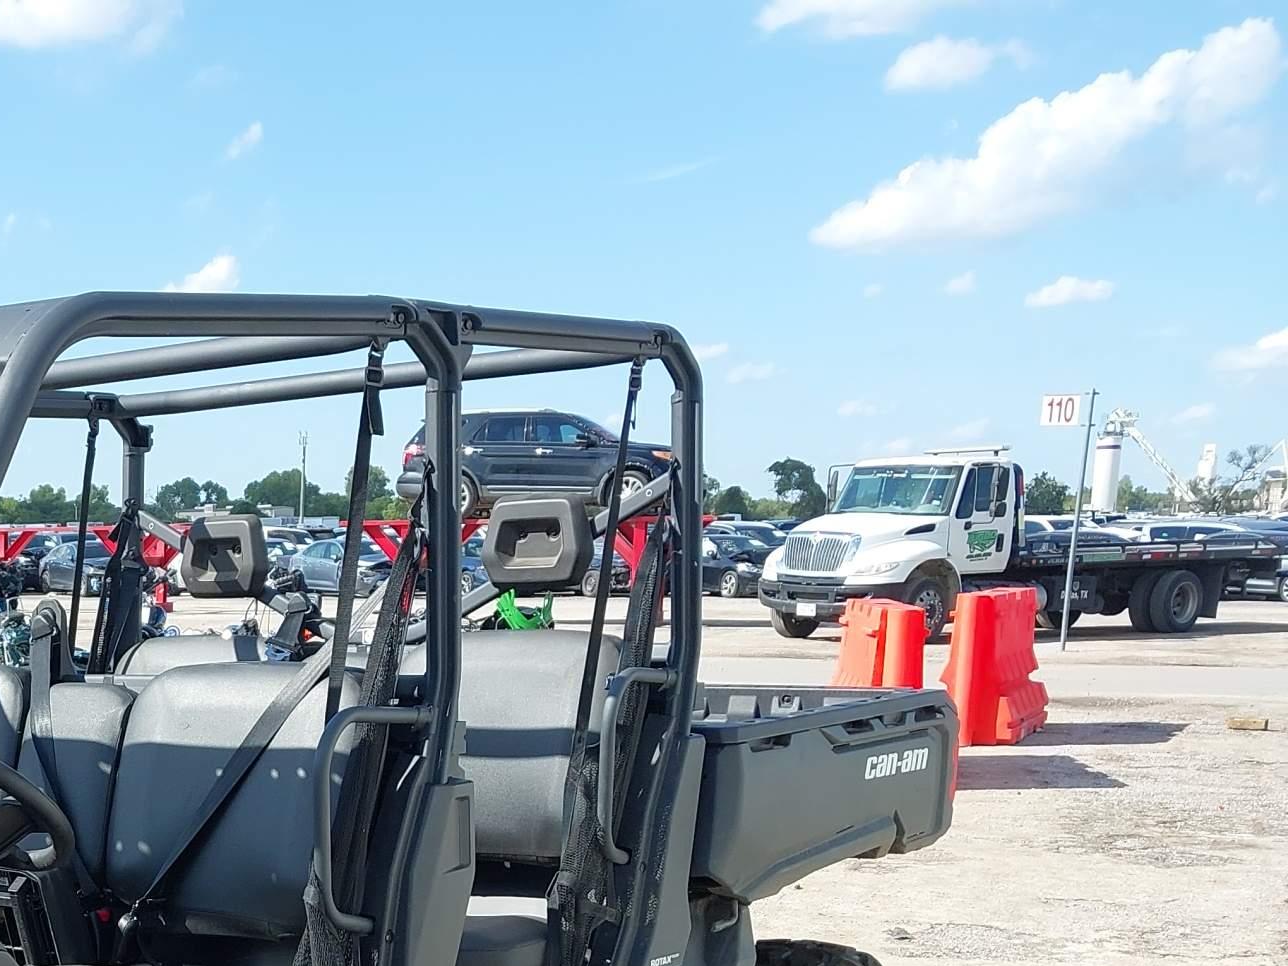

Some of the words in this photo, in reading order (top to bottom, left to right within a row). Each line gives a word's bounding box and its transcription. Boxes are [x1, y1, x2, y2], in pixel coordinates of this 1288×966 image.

[1047, 397, 1075, 423] 110
[1080, 589, 1089, 600] TX
[864, 747, 929, 780] can-am
